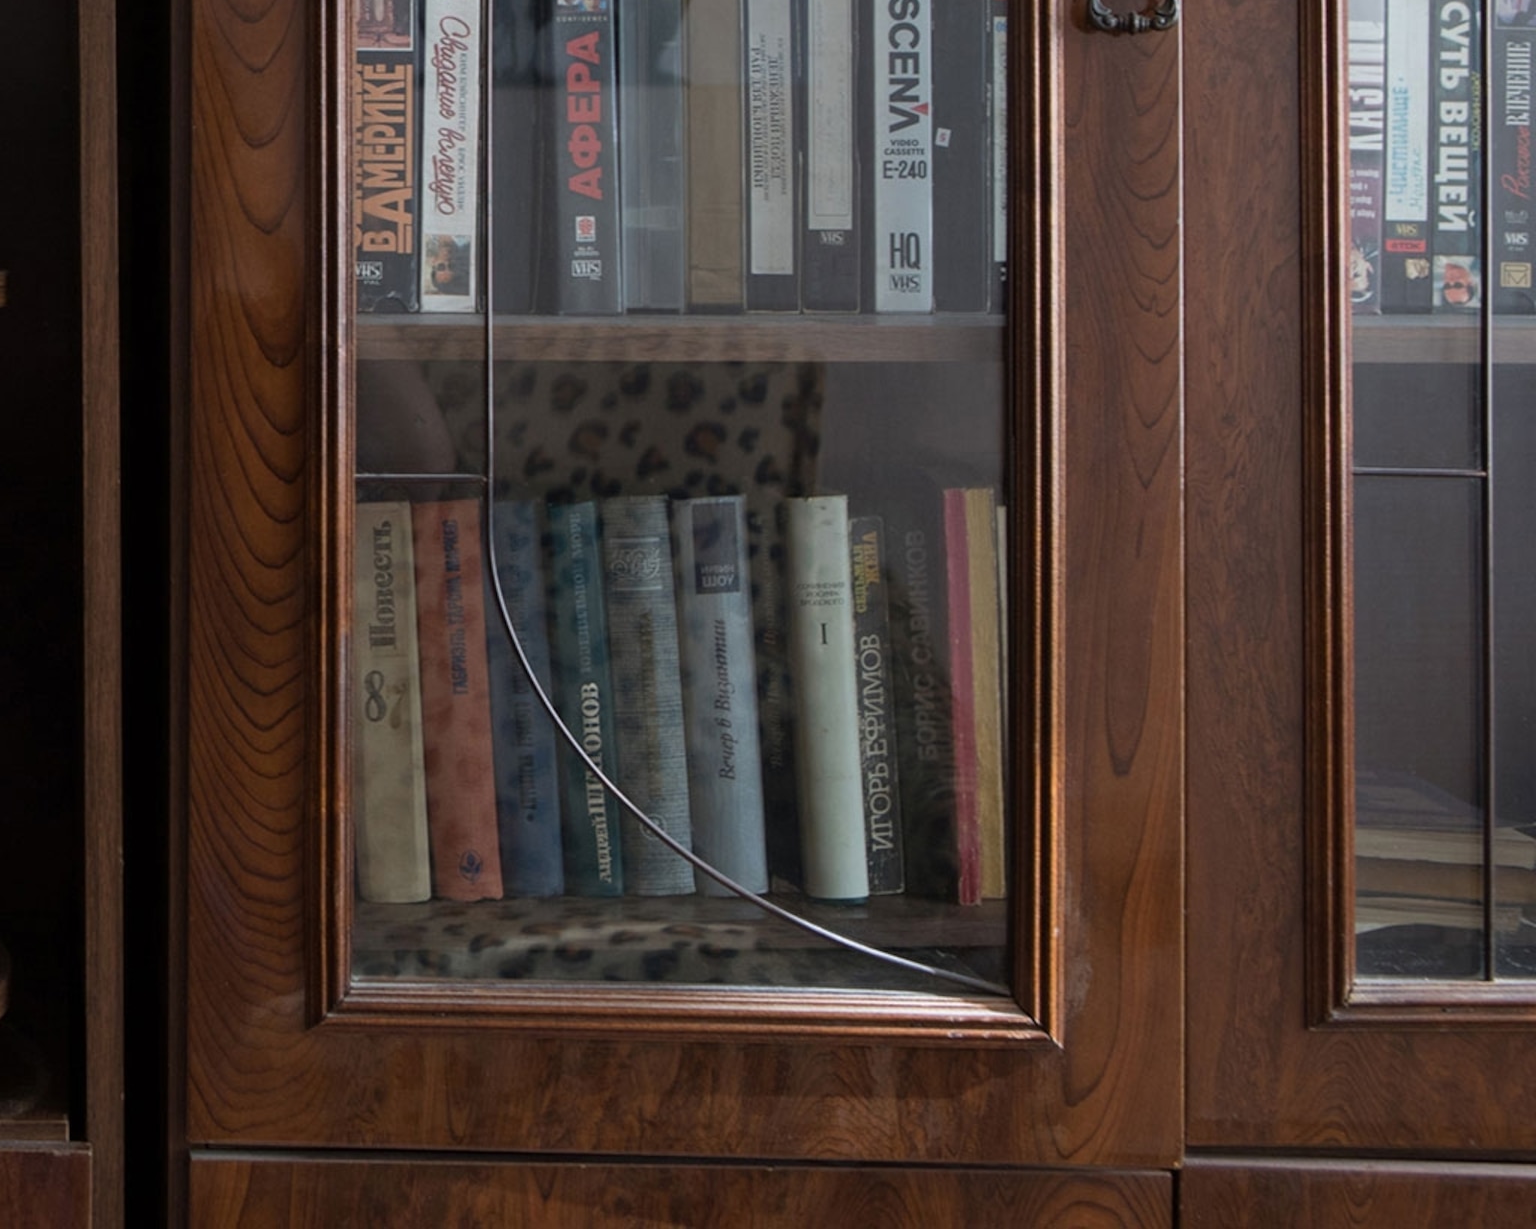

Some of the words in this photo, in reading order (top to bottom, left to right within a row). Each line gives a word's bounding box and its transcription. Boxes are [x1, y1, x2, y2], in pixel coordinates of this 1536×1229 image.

[432, 15, 472, 119] Свидание
[1439, 1, 1471, 89] СУТЬ
[1506, 41, 1532, 126] ВЛЕЧЕНИЕ
[362, 64, 413, 225] АМЕРИКЕ
[567, 30, 604, 201] АФЕРА
[429, 127, 464, 215] вслепую
[883, 161, 927, 179] E-240
[1434, 100, 1475, 231] ВЕЩЕЙ
[573, 261, 601, 276] VHS
[890, 233, 921, 269] HQ
[891, 275, 920, 289] VHS
[1505, 232, 1528, 245] VHS
[368, 519, 398, 651] Повесть
[702, 575, 734, 588] ШОУ
[864, 531, 881, 584] ЖЕНА
[905, 529, 933, 664] САВИНКОВ
[713, 619, 731, 712] Византии
[859, 634, 889, 757] ЕФИМОВ
[716, 733, 738, 781] Вечер
[913, 673, 939, 761] БОРИС
[868, 762, 895, 851] ИГОРЬ
